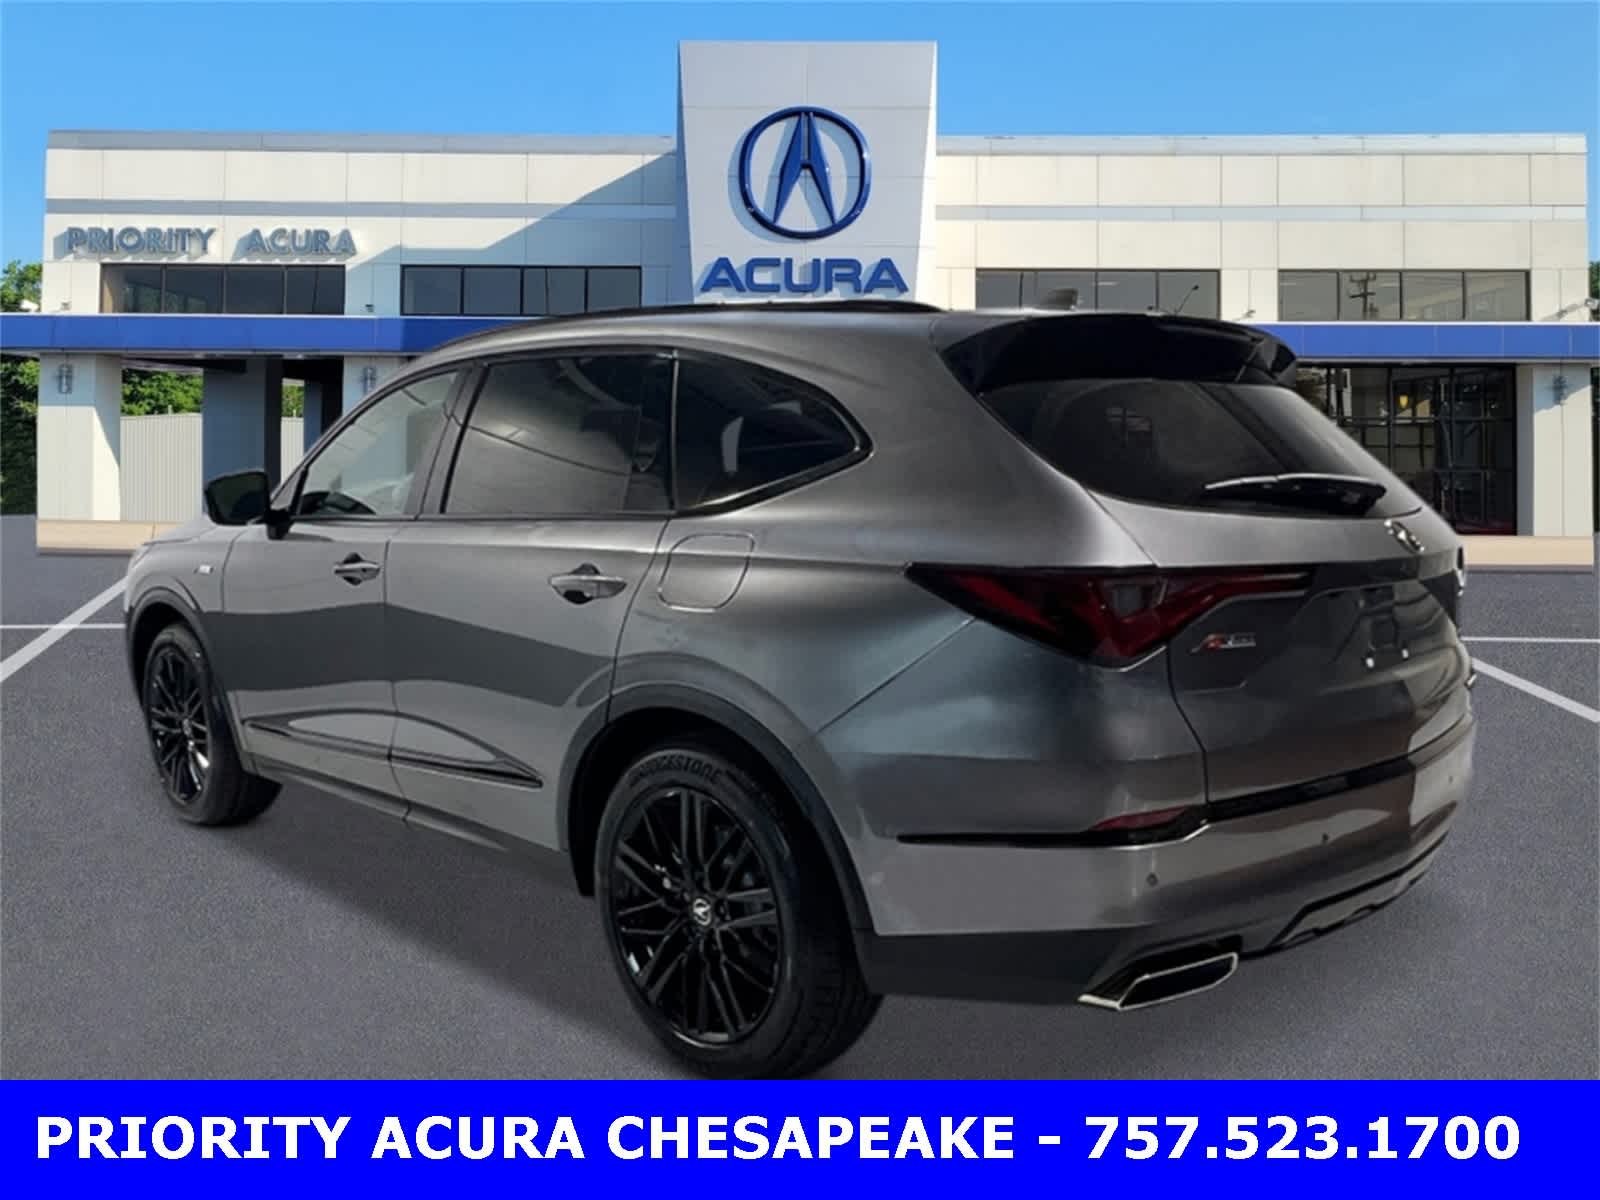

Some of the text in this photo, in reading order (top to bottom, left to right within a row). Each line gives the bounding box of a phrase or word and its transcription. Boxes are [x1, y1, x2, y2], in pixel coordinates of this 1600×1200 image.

[66, 226, 356, 256] PRIORITY ACURA
[701, 257, 909, 294] ACURA
